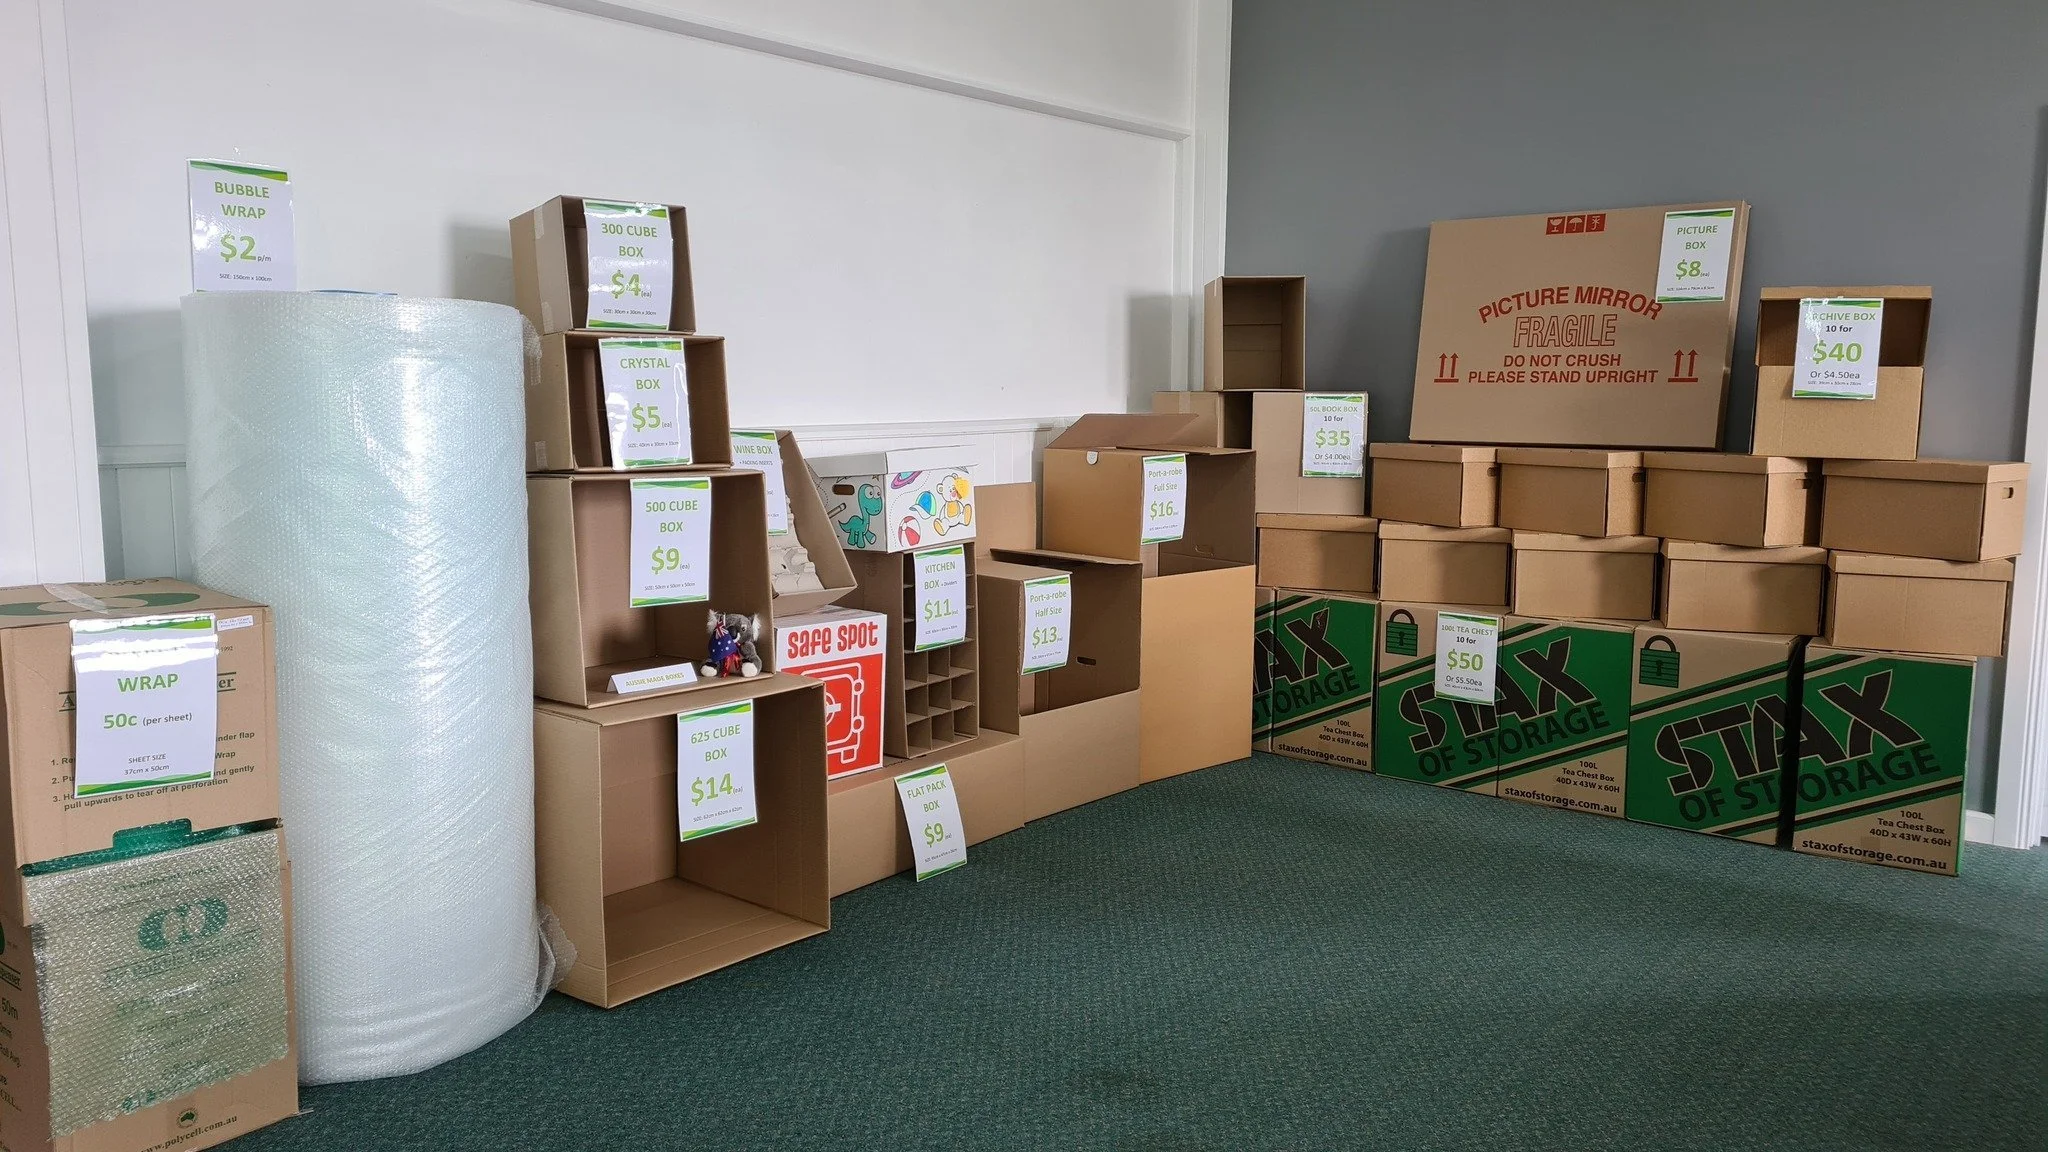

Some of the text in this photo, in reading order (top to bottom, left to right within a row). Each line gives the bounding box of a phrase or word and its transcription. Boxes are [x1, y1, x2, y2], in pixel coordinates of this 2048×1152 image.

[215, 181, 269, 198] BUBBLE
[221, 204, 266, 219] WRAP
[601, 223, 658, 237] 300 CUBE
[1677, 225, 1718, 235] PICTURE
[619, 245, 643, 257] BOX
[1685, 241, 1706, 250] BOX
[1478, 286, 1663, 324] PICTURE MIRROR
[1808, 312, 1876, 321] RCHIVE BOX
[1513, 313, 1618, 347] FRAGILE
[1839, 325, 1853, 333] for
[1812, 340, 1862, 364] $40
[620, 358, 670, 368] CRYSTAL
[1504, 353, 1622, 367] DO NOT CRUSH
[1468, 369, 1659, 383] PLEASE STAND UPRIGHT
[1810, 370, 1860, 379] Or $4.50ea
[636, 379, 660, 389] BOX
[1315, 427, 1350, 448] $35
[733, 444, 773, 454] WINE BOX
[1148, 467, 1182, 478] Port-a-robe
[1153, 482, 1177, 492] Full Size
[645, 500, 698, 512] 500 CUBE
[1150, 500, 1173, 521] $16
[660, 521, 683, 533] BOX
[925, 561, 955, 574] KITCHEN
[924, 579, 939, 590] BOX
[1030, 590, 1067, 603] Port-a-robe
[924, 598, 952, 622] $11
[1035, 605, 1062, 618] Half Size
[1032, 626, 1057, 648] $13
[1471, 628, 1493, 636] CHEST
[1466, 636, 1476, 644] for
[1447, 648, 1483, 671] $50
[117, 673, 178, 692] WRAP
[626, 672, 684, 687] AUSSIE MADE BOXES
[1253, 666, 1361, 720] TORAGE
[103, 712, 192, 729] 50c (per sheet)
[1336, 719, 1351, 728] 100L
[238, 730, 255, 741] flap
[691, 724, 741, 744] 625 CUBE
[1323, 725, 1365, 739] Tea Chest Box
[1417, 701, 1612, 777] OF STORAGE
[1655, 669, 1924, 796] STAX
[1318, 733, 1369, 749] 40D 43W 60H
[128, 753, 166, 764] SHEET SIZE
[705, 747, 727, 762] BOX
[1278, 743, 1368, 767] staxofstorage.com.au
[228, 764, 255, 775] gently
[1579, 760, 1598, 770] 100L
[1562, 767, 1615, 783] Tea Chest Box
[691, 773, 733, 806] $14
[907, 779, 946, 799] FLAT PACK
[1556, 776, 1572, 786] 40D
[1578, 779, 1597, 790] 43W
[1603, 783, 1620, 793] 60H
[1678, 743, 1941, 823] OF STORAGE
[52, 795, 61, 803] 3.
[64, 800, 82, 811] pull
[84, 793, 123, 808] upwards
[125, 792, 135, 800] to
[136, 790, 154, 798] tear
[156, 786, 168, 795] off
[181, 776, 228, 791] perforation
[1504, 785, 1617, 814] staxofstorage.com.au
[923, 800, 940, 813] BOX
[1899, 810, 1923, 821] 100L
[1877, 817, 1945, 835] Tea Chest Box
[1869, 827, 1889, 838] 40D
[1898, 831, 1921, 843] 43W
[1931, 836, 1951, 848] 60H
[1802, 837, 1947, 869] staxofstorage.com.au
[141, 1115, 237, 1152] ww.polycell.com.au
